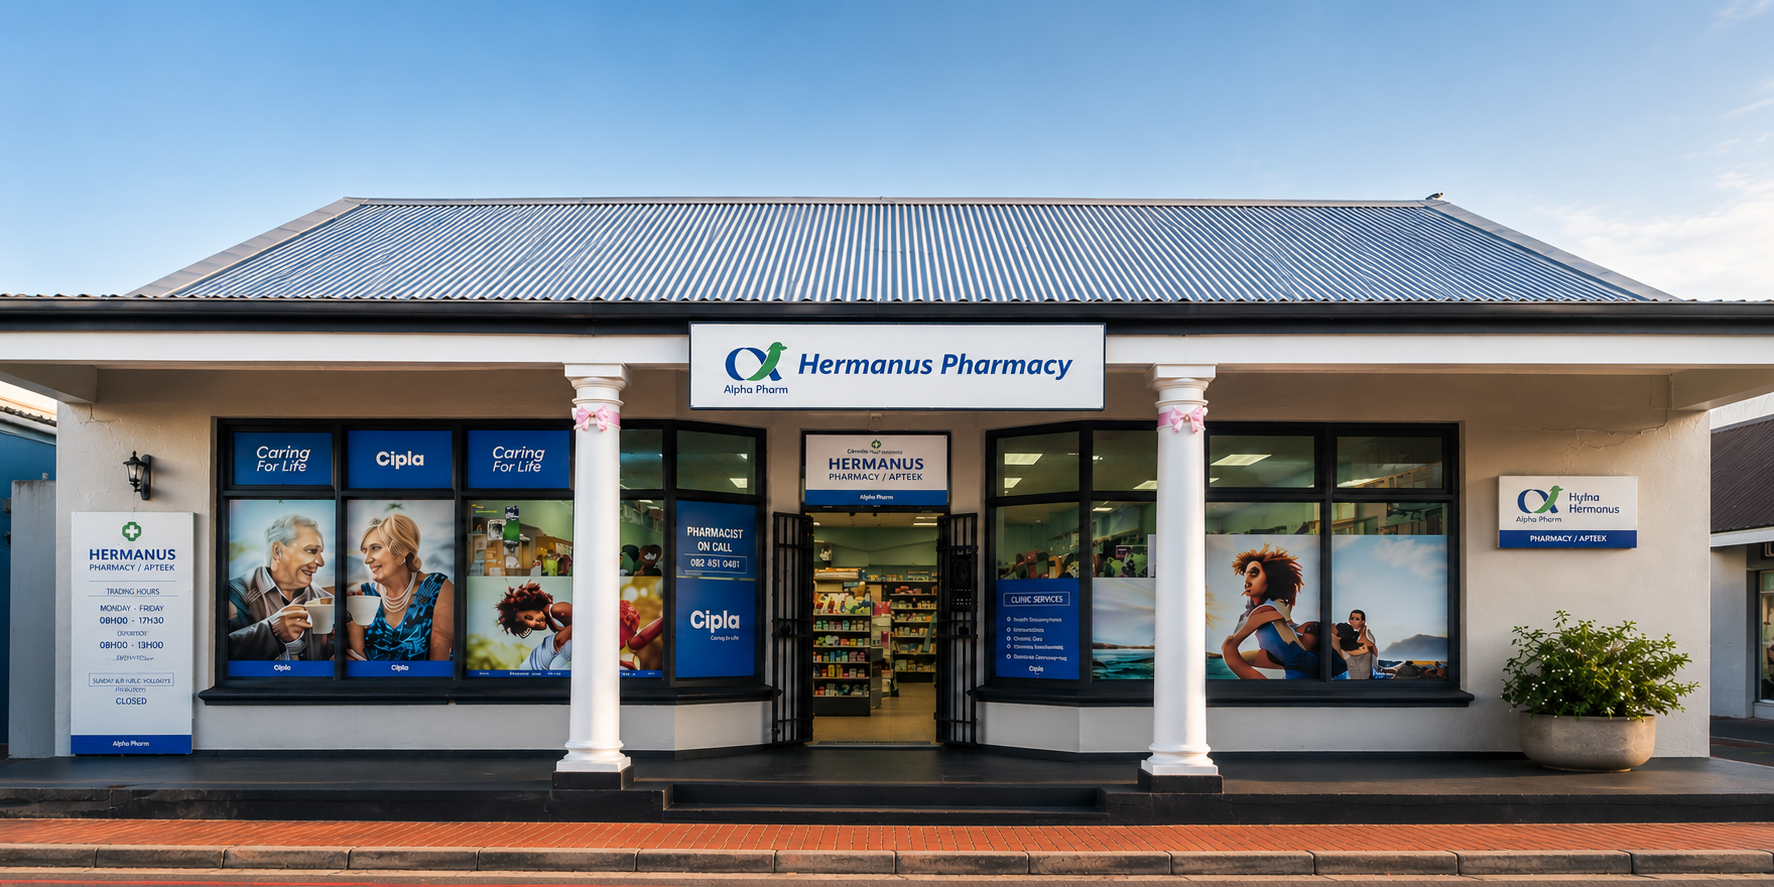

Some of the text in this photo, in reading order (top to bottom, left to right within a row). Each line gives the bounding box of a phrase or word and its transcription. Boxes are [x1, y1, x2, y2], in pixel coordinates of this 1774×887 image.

[798, 354, 1073, 380] Hermanus Pharmacy
[724, 385, 788, 396] Alpha Pharm
[256, 446, 311, 462] Caring
[376, 450, 424, 470] Cipla
[492, 446, 546, 462] Caring
[256, 460, 307, 472] For Life
[492, 460, 542, 473] For Life
[829, 458, 924, 470] HERMANUS
[829, 473, 880, 481] PHARMACY
[889, 473, 923, 481] APTEEK
[1516, 516, 1537, 524] Alpha
[686, 526, 744, 539] PHARMACIST
[697, 541, 733, 553] ON CALL
[89, 549, 176, 560] HERMANUS
[1033, 595, 1063, 603] SERVICES
[99, 616, 128, 625] 08H00
[689, 610, 740, 633] Cipla
[99, 641, 128, 649] 08H00
[115, 697, 147, 705] CLOSED
